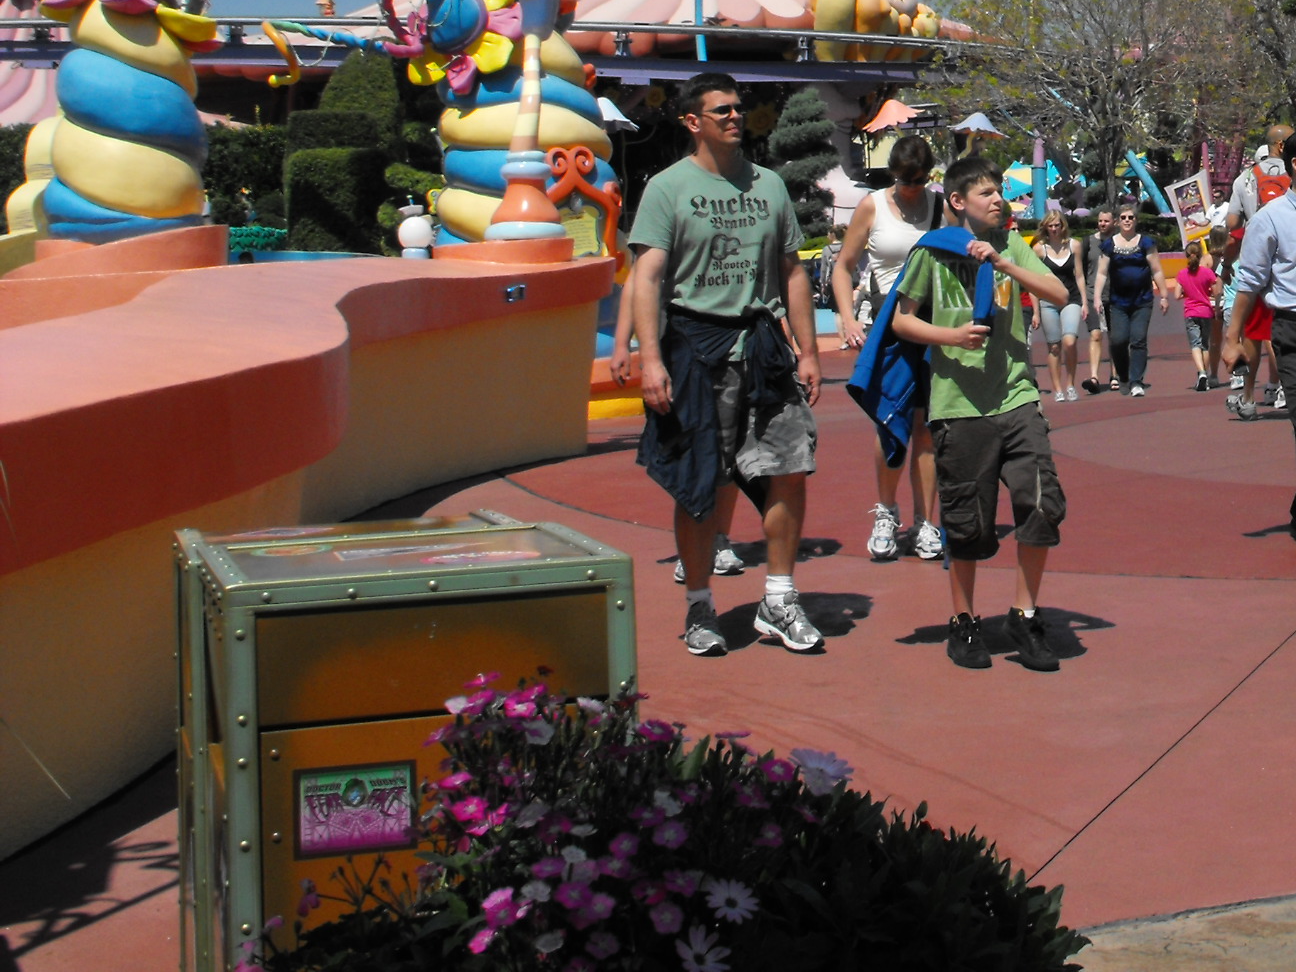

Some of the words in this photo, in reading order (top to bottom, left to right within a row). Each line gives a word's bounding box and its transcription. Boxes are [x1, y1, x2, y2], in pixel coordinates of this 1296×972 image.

[690, 193, 770, 221] Lucky
[710, 215, 757, 230] Brand
[712, 259, 751, 271] Rooted
[694, 271, 730, 288] Rock
[304, 783, 341, 794] DOCTOR
